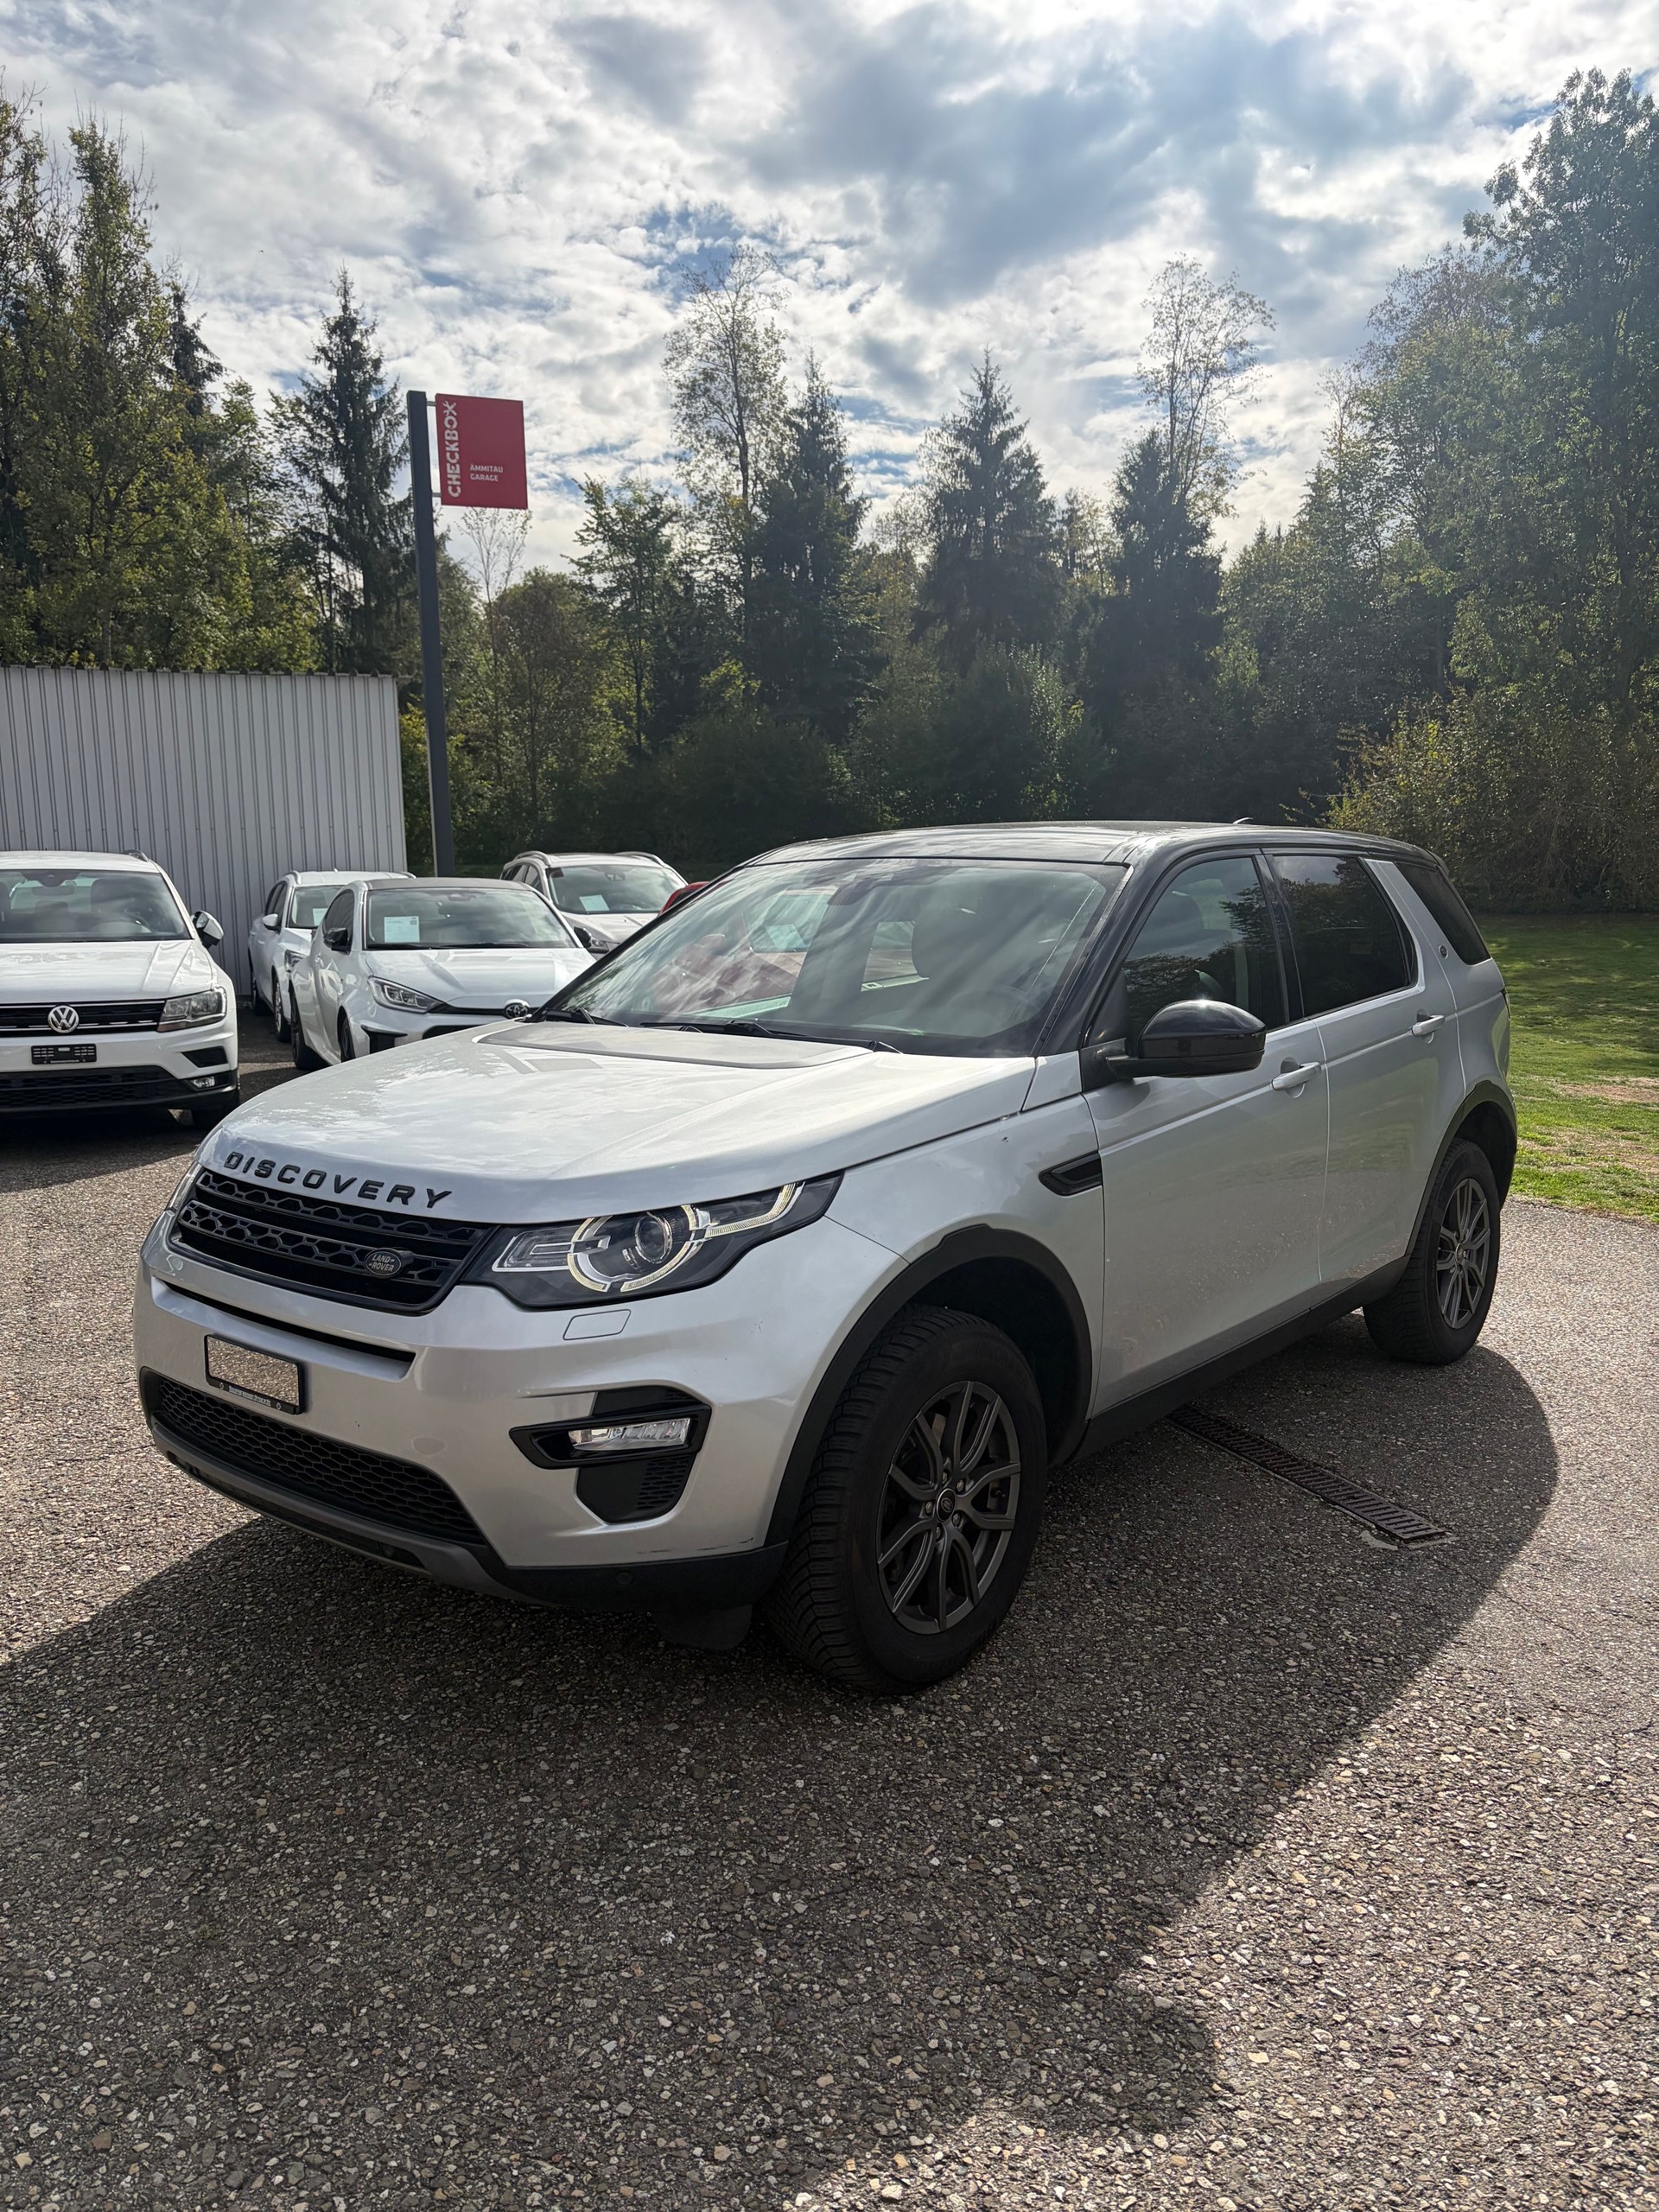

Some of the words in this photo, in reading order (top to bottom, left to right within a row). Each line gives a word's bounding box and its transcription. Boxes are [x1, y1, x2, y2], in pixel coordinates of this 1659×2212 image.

[442, 400, 461, 498] CHECKBOX
[470, 474, 499, 482] GARAGE
[49, 1006, 78, 1033] VW
[224, 1151, 452, 1208] DISCOVERY
[371, 1262, 395, 1272] ROVER
[372, 1254, 391, 1263] LAND
